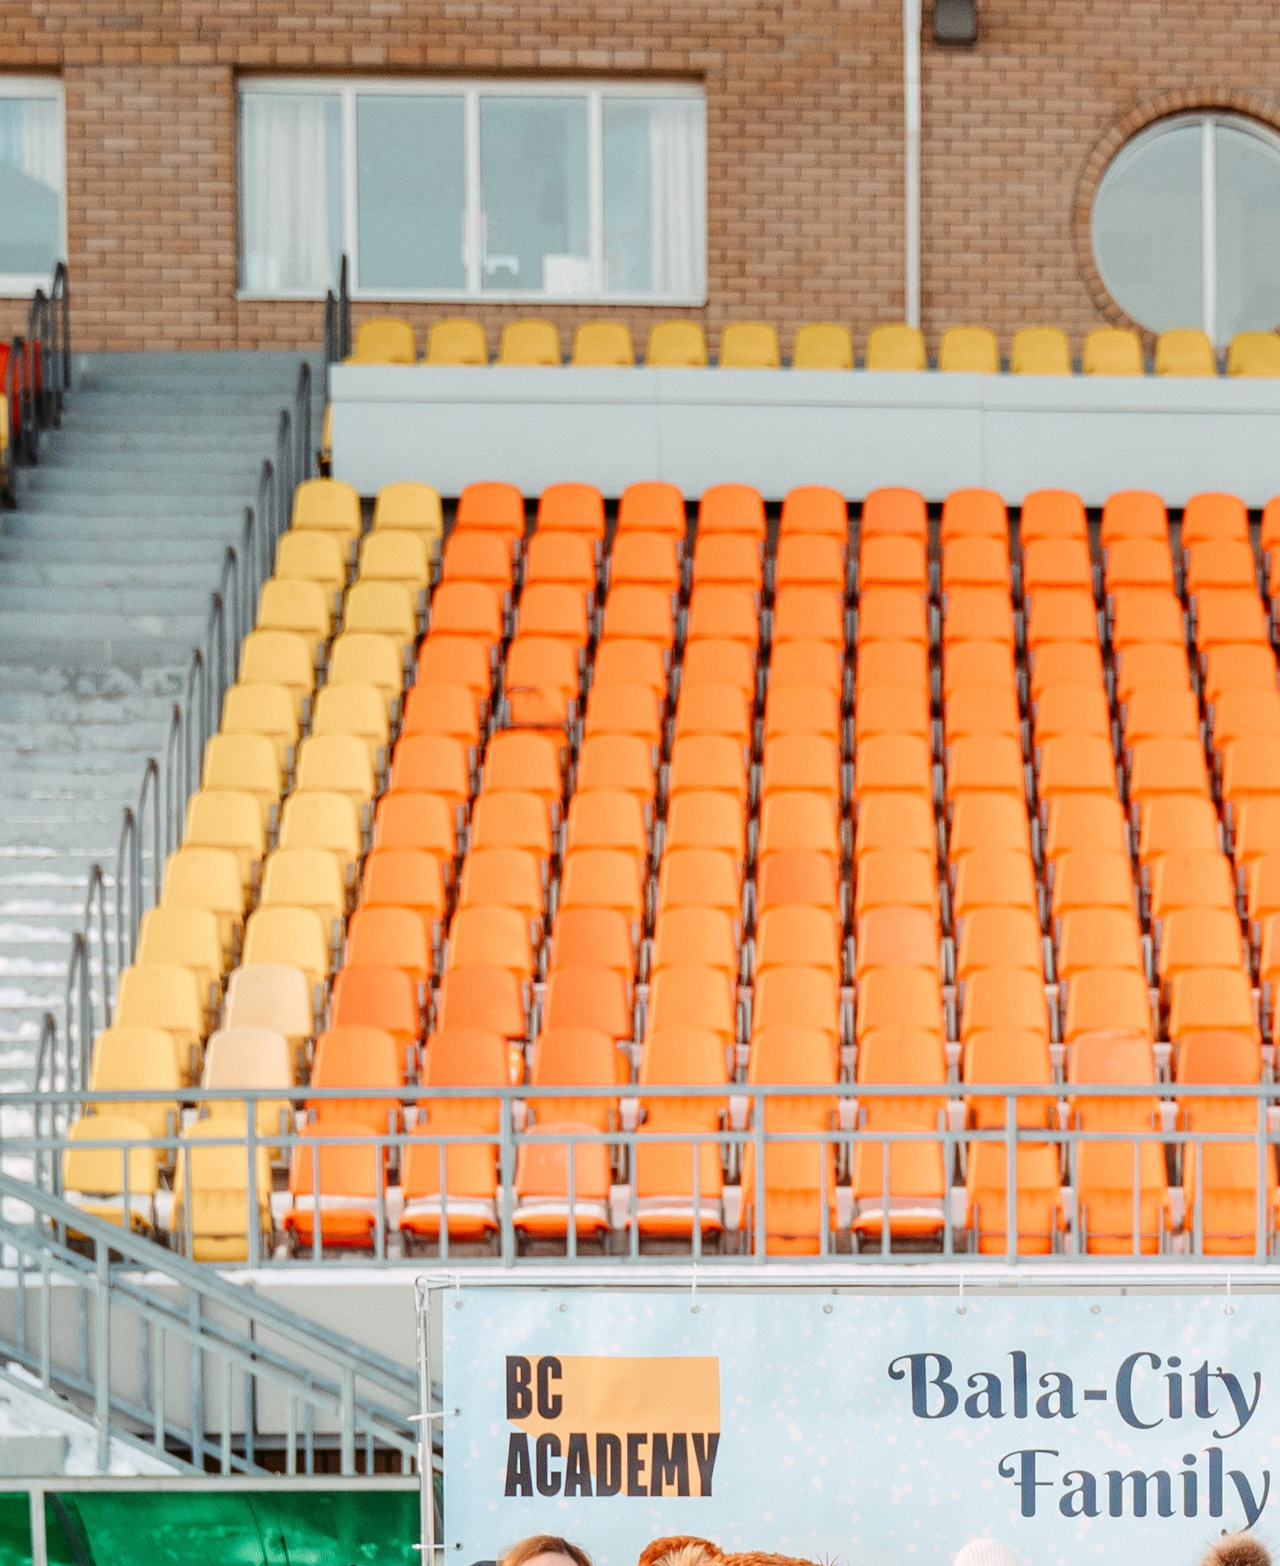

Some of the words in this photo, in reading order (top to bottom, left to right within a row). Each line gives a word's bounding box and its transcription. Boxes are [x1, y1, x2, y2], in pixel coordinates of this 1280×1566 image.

[505, 1355, 563, 1420] BC
[887, 1350, 1262, 1439] Bala-City
[504, 1432, 721, 1498] ACADEMY
[998, 1446, 1271, 1536] Family
